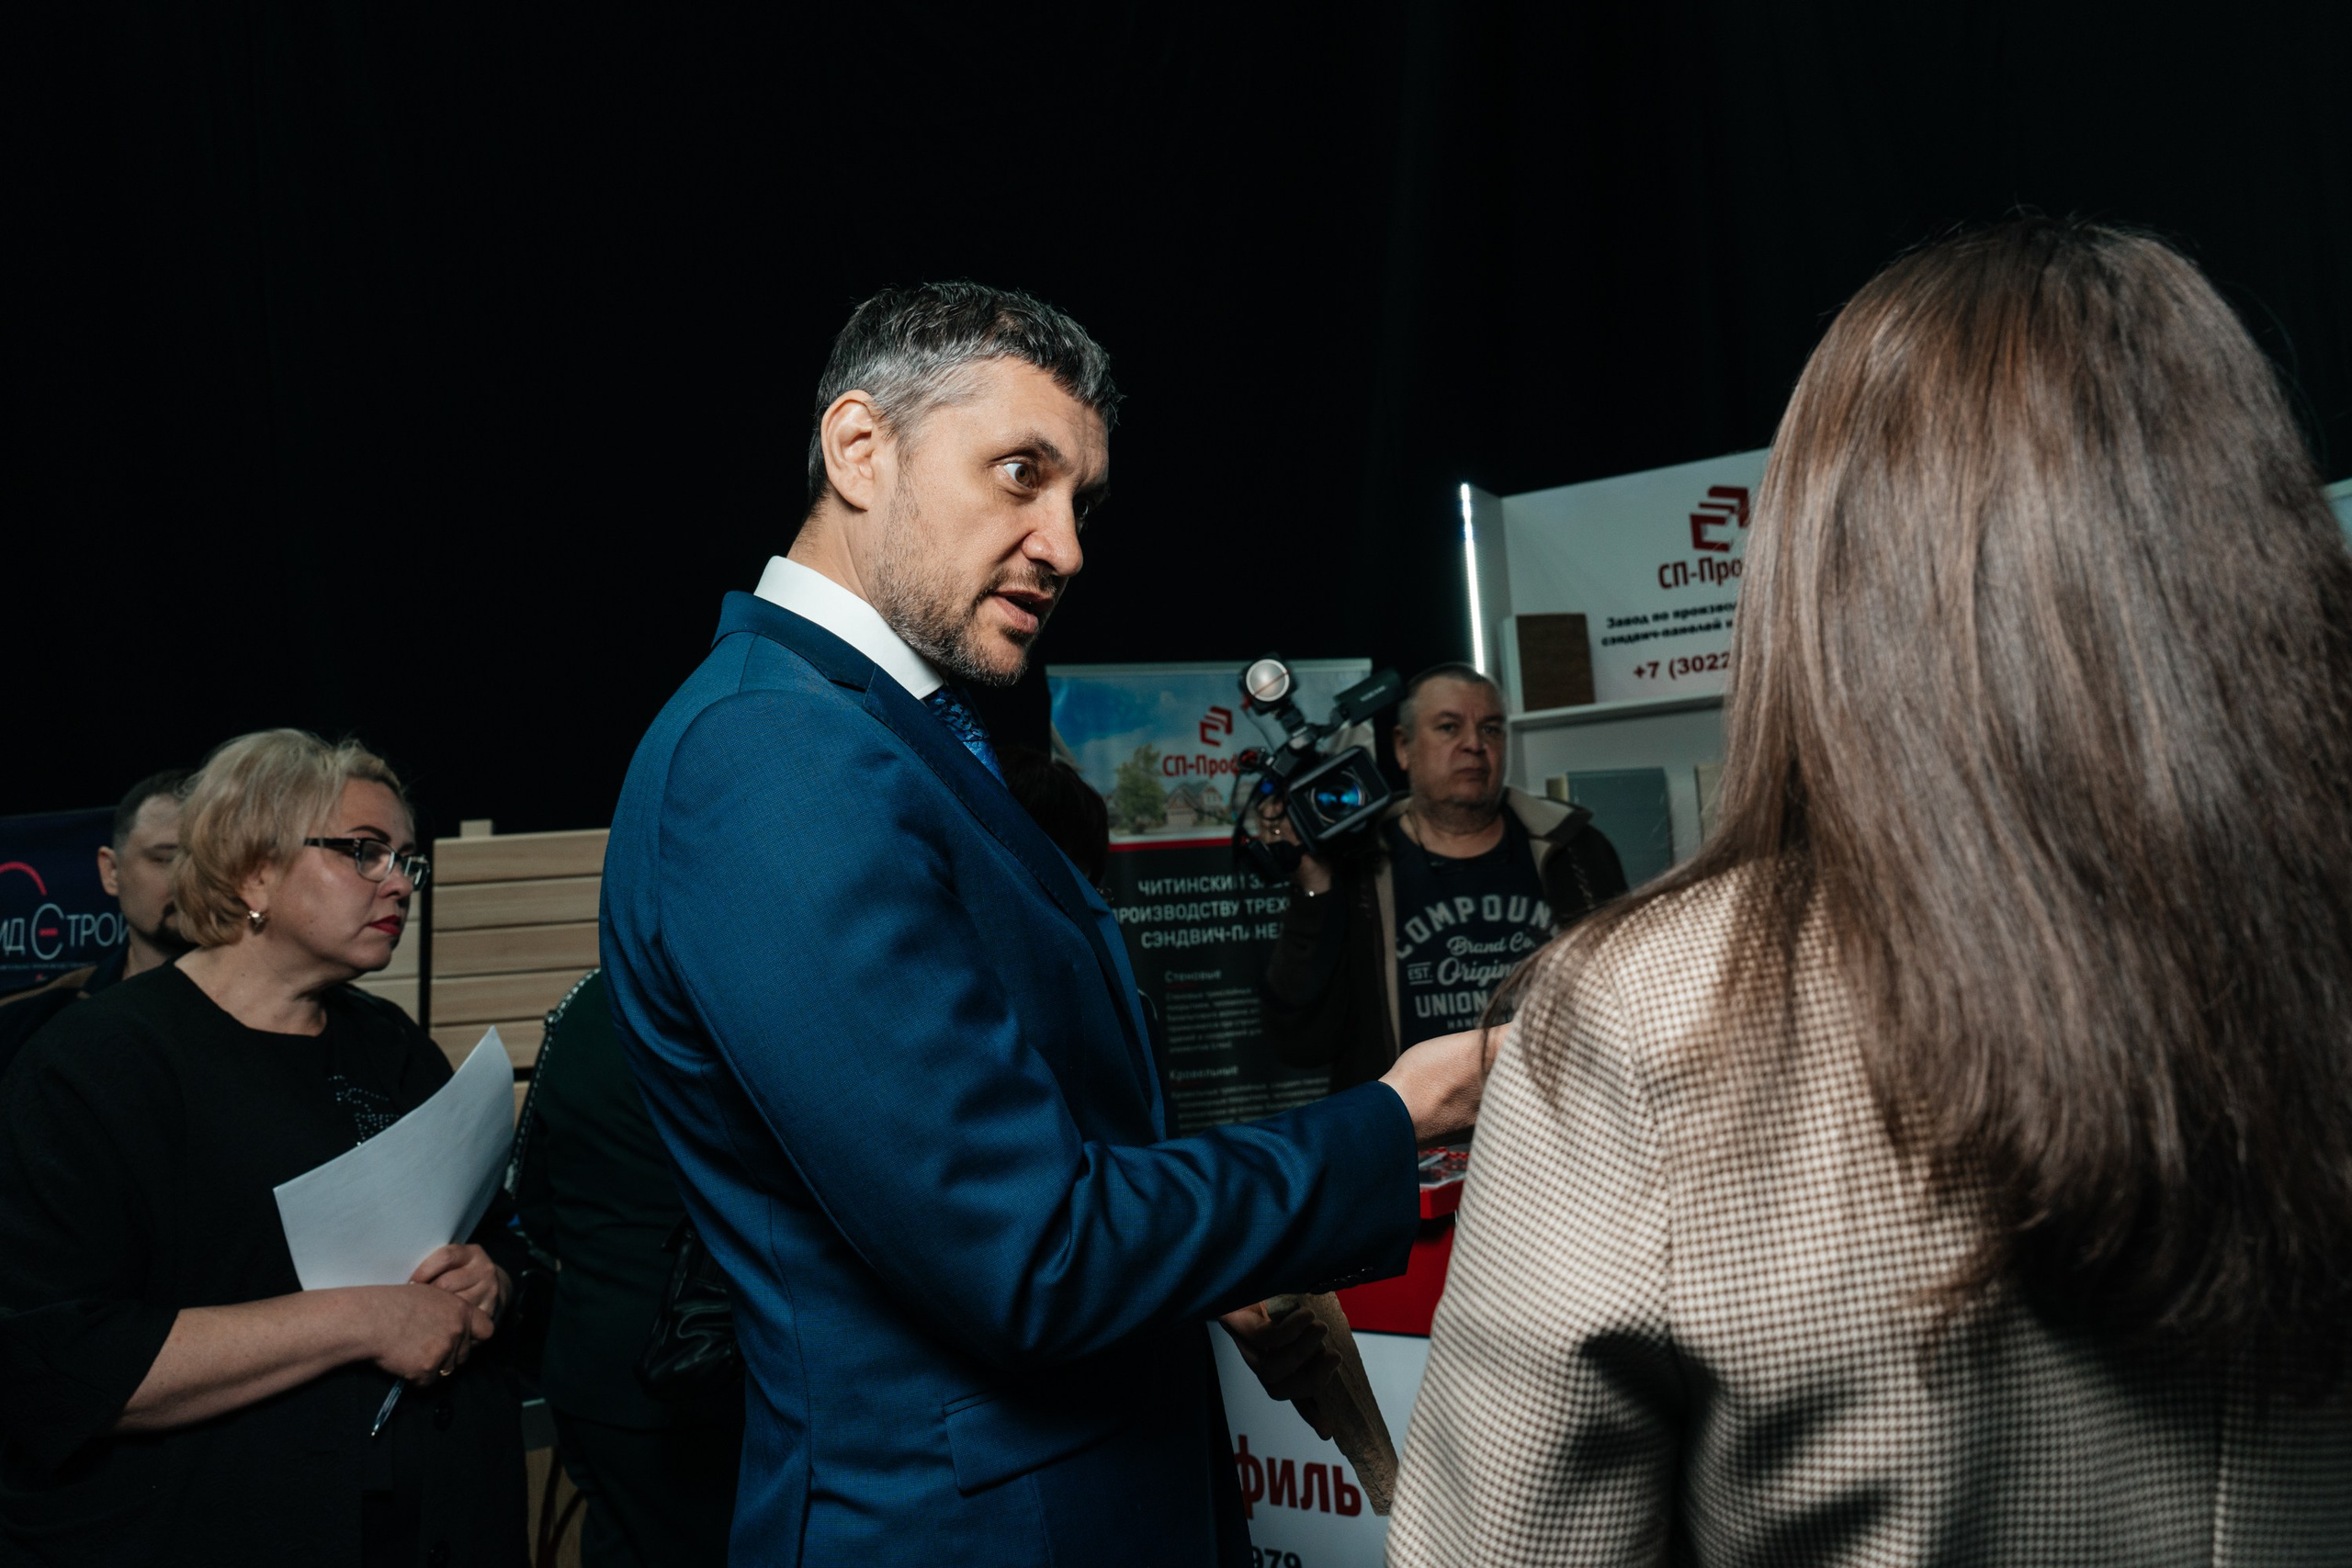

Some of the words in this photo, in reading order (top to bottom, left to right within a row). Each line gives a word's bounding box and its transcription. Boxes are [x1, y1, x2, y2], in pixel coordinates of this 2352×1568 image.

[1658, 557, 1744, 589] СП-Про
[1673, 602, 1737, 619] произво
[1634, 661, 1659, 678] +7
[1244, 896, 1291, 916] ТРЕХ
[1140, 921, 1284, 949] СЭНДВИЧ-ПНЕ
[1396, 894, 1560, 960] COMPOUN
[1446, 935, 1506, 956] Brand
[1408, 966, 1433, 981] EST.
[1415, 989, 1487, 1018] UNION
[1235, 1435, 1362, 1519] филь
